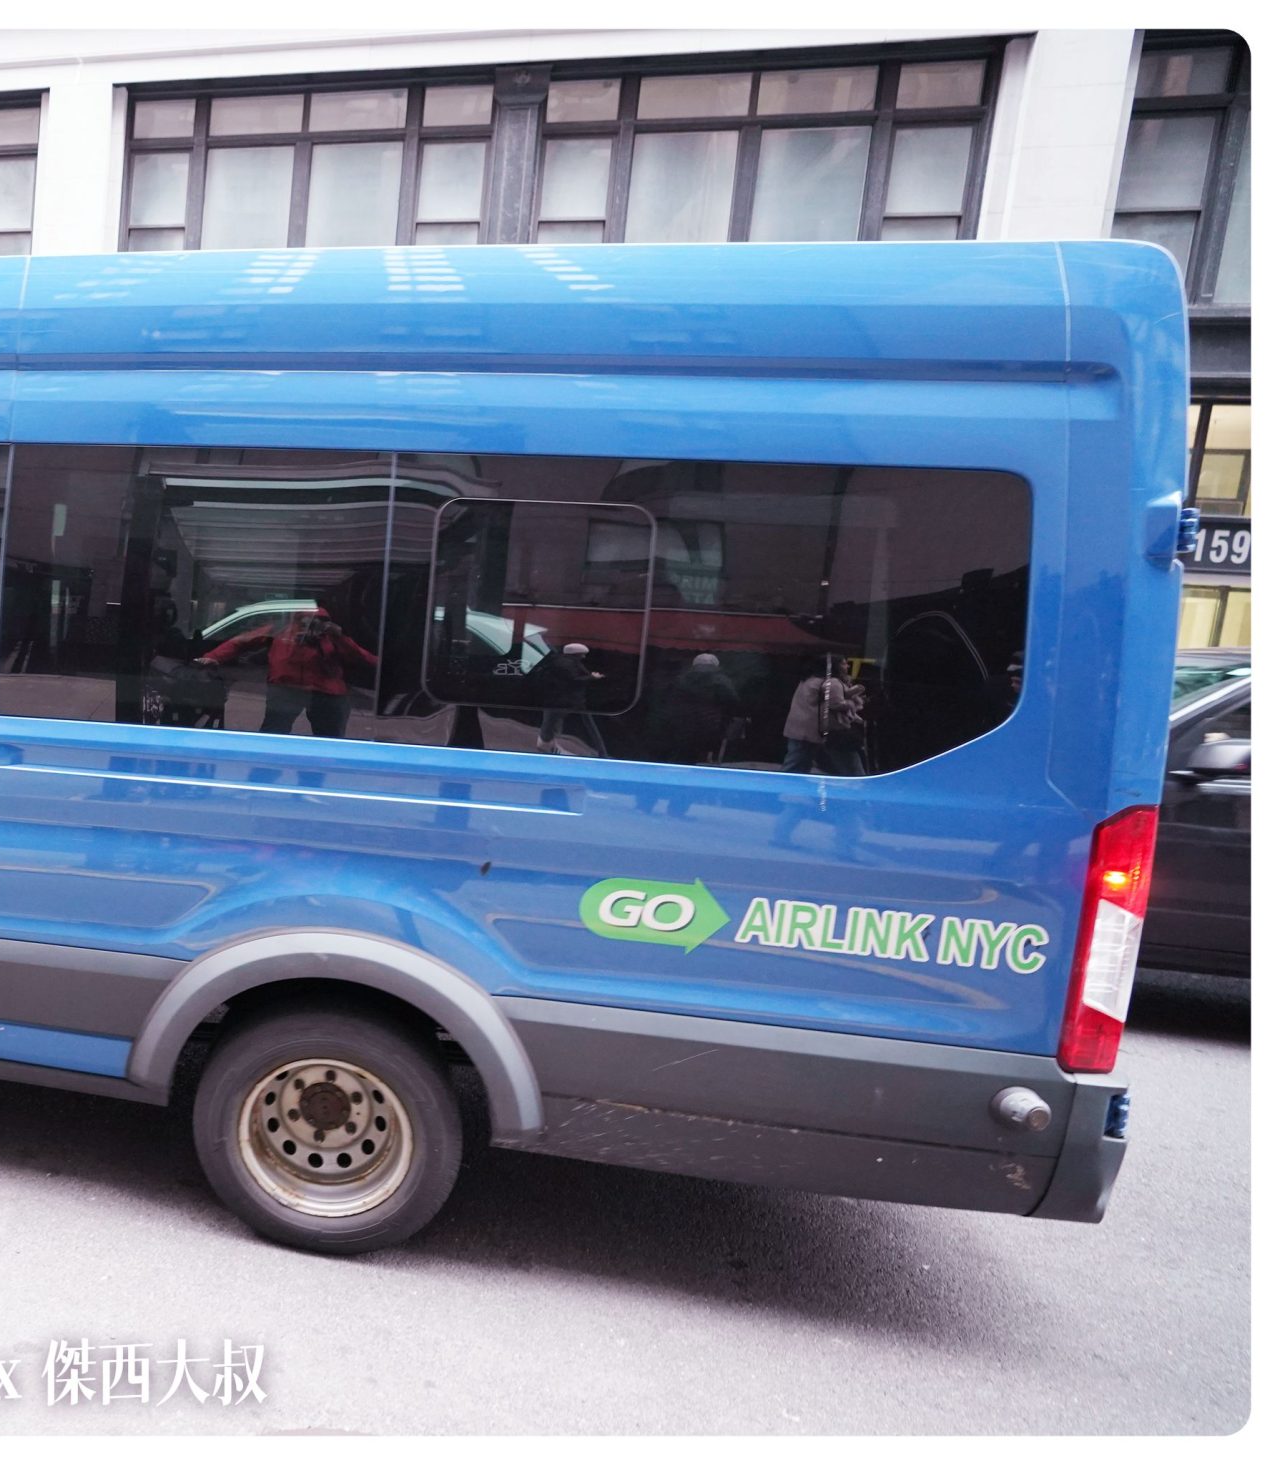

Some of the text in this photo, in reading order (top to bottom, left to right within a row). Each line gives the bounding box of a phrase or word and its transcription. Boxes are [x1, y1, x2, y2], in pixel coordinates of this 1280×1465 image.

[1194, 528, 1251, 564] 159
[598, 889, 1050, 975] GO AIRLINK NYC
